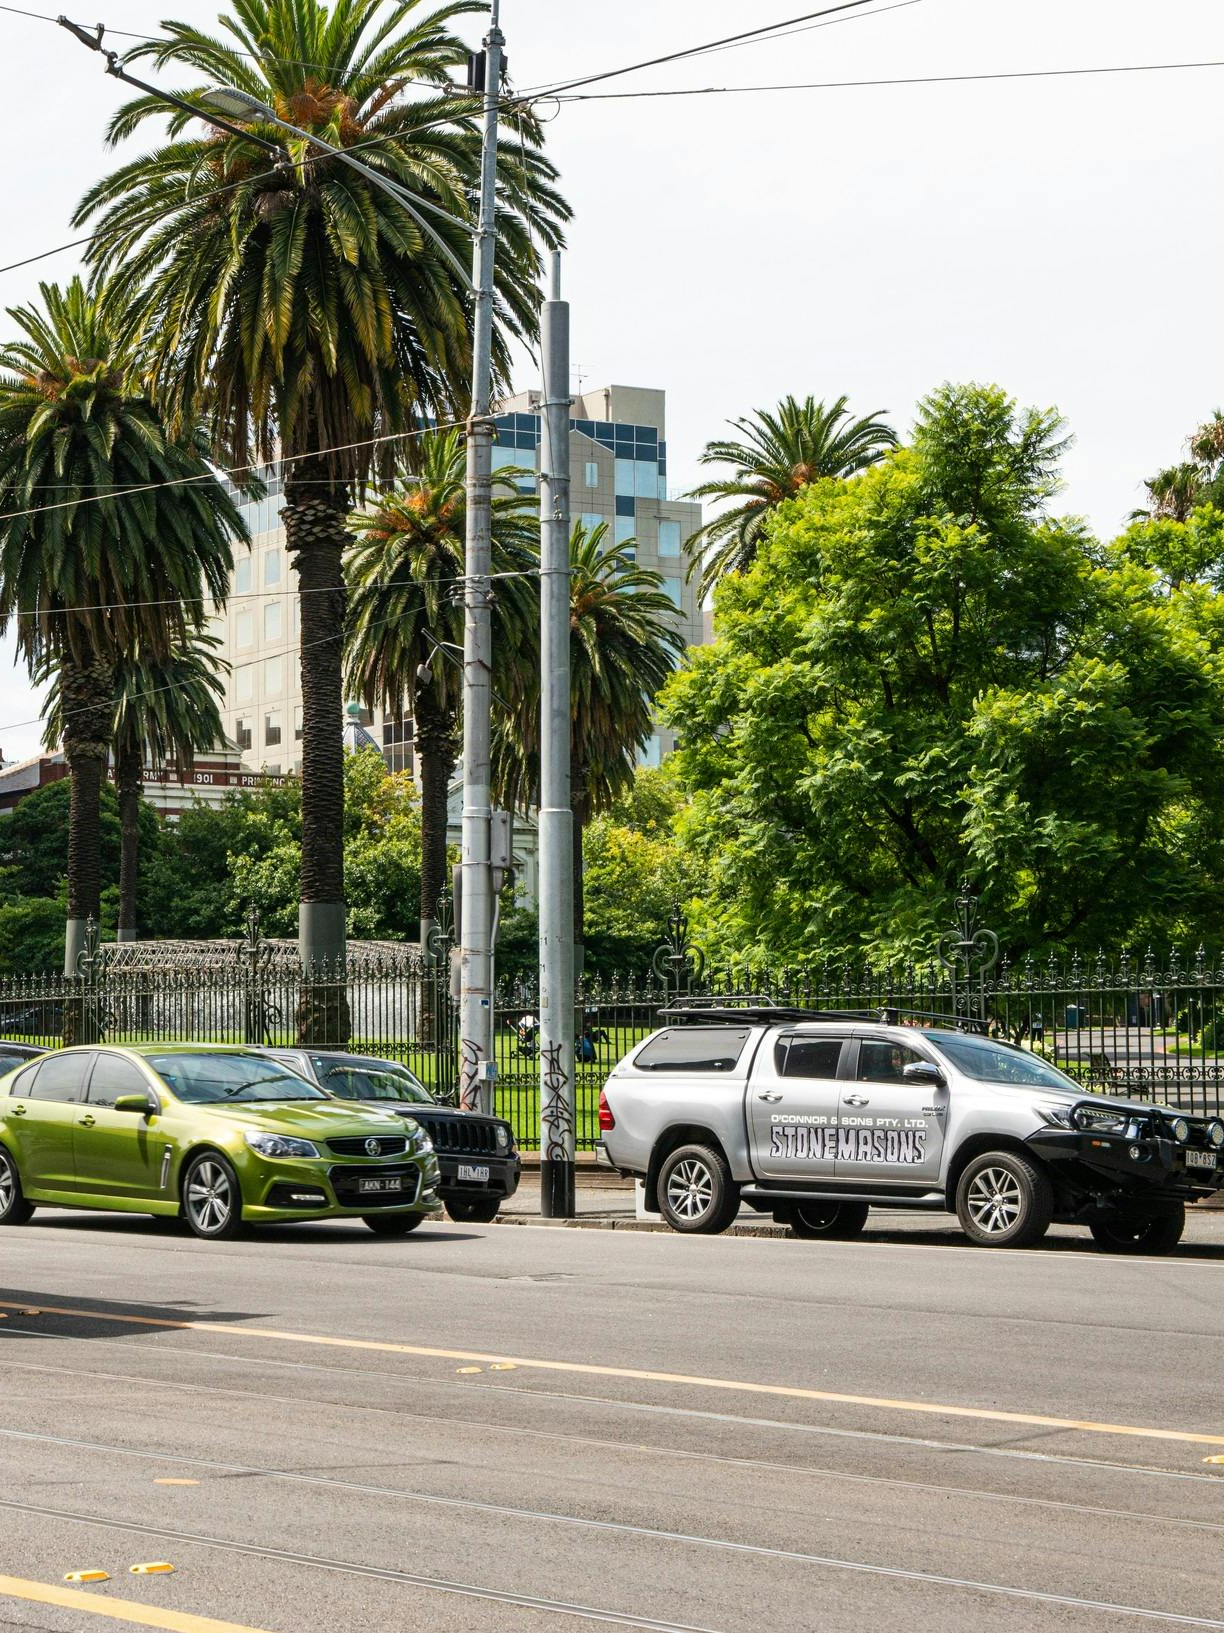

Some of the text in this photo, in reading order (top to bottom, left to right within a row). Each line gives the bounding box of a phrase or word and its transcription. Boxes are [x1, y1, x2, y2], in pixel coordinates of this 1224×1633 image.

[771, 1114, 928, 1128] O'CONNOR & SONS PTY. LTD.
[770, 1125, 927, 1164] STONEMASONS
